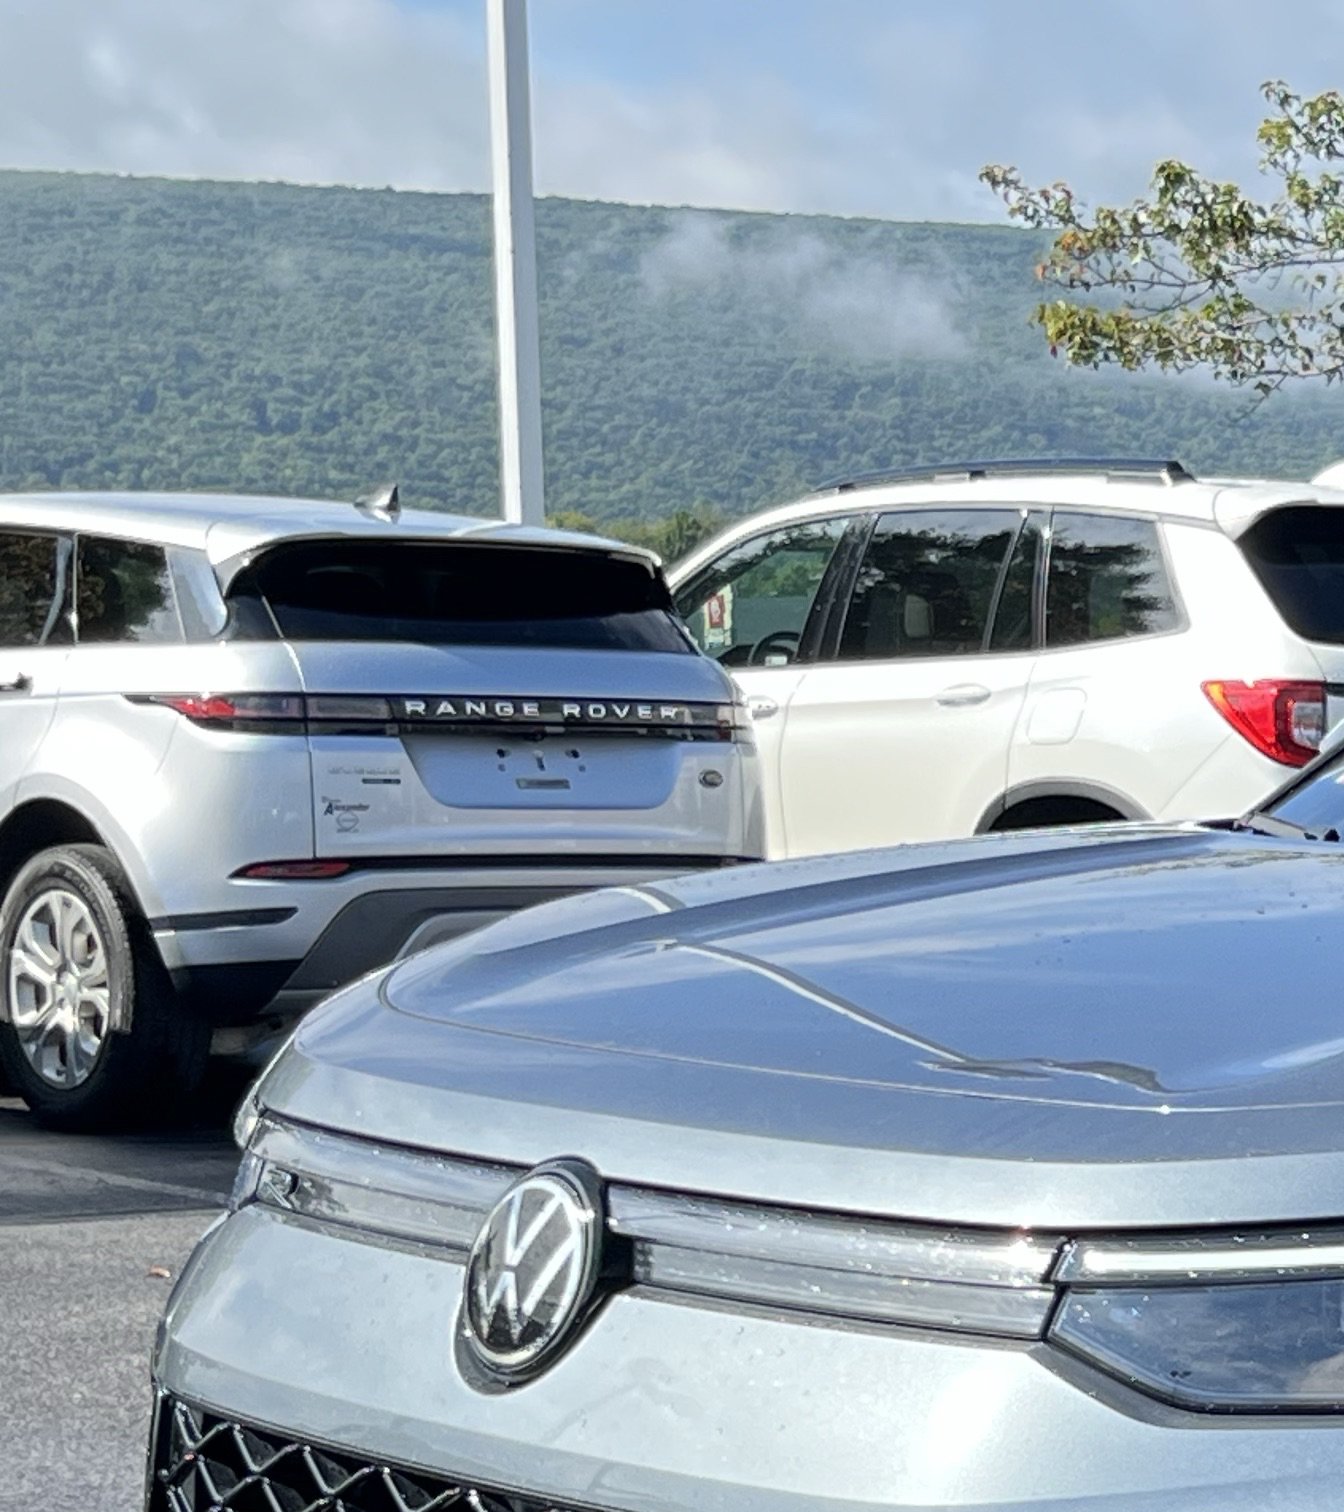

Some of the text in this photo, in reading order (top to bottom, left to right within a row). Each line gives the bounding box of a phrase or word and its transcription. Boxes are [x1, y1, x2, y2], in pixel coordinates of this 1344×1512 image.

[404, 700, 680, 720] RANGE ROVER
[468, 1178, 583, 1366] VW
